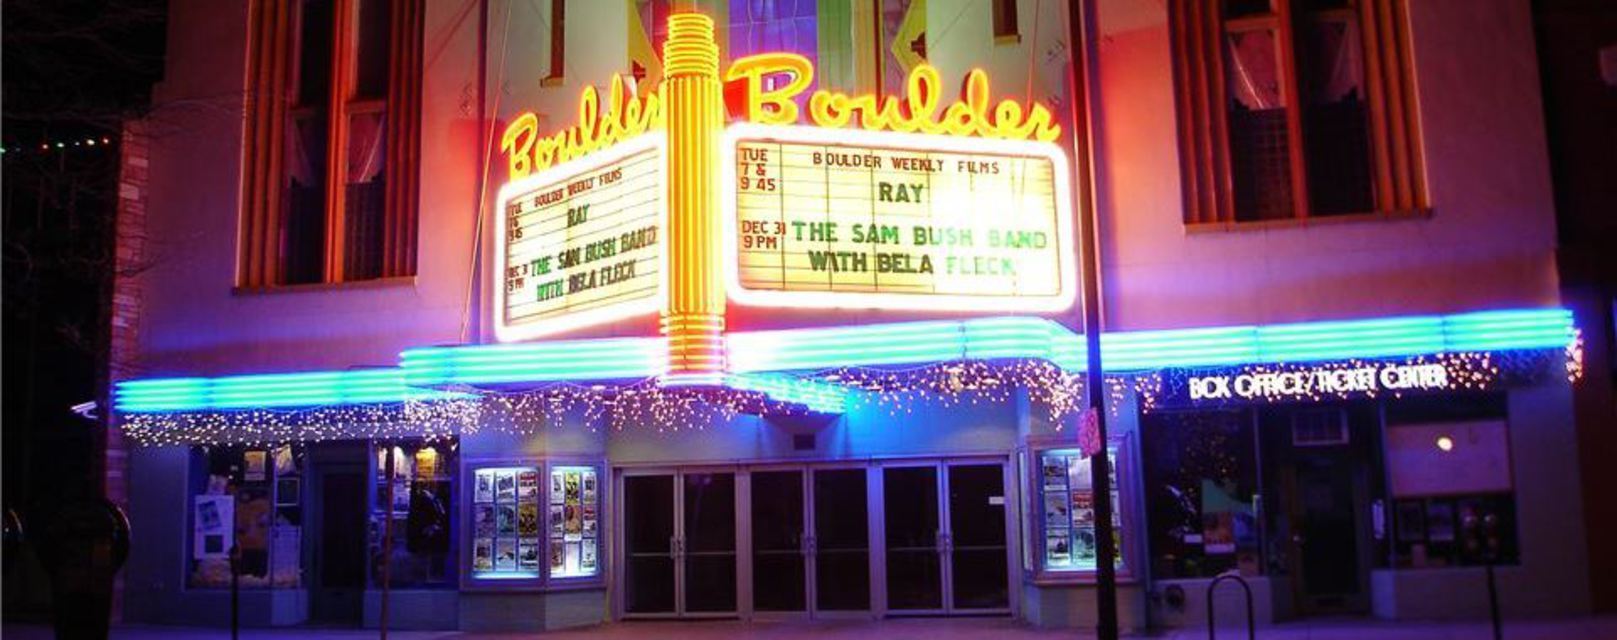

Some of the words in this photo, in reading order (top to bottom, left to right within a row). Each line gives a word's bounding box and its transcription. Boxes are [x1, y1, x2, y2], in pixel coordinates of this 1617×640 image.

[727, 52, 1061, 142] Boulder
[502, 72, 662, 180] Boulder
[741, 148, 768, 162] TUE
[813, 152, 882, 168] BOULDER
[891, 157, 944, 172] WEEKLY
[958, 161, 1000, 174] FILMS
[740, 163, 749, 175] 7
[756, 163, 766, 176] &
[740, 177, 750, 191] 9
[756, 178, 776, 191] 45
[879, 182, 923, 203] RAY
[534, 188, 563, 207] BOULDER
[567, 204, 590, 228] RAY
[741, 221, 769, 234] DEC
[774, 222, 786, 235] 31
[792, 221, 838, 242] THE
[852, 224, 899, 245] SAM
[913, 225, 973, 246] BUSH
[989, 229, 1048, 249] BAND
[531, 256, 552, 277] THE
[557, 247, 580, 270] SAM
[585, 236, 616, 263] BUSH
[621, 226, 657, 253] BAND
[743, 236, 753, 248] 9
[756, 237, 777, 249] PM
[808, 250, 867, 272] WITH
[877, 252, 934, 275] BELA
[946, 257, 1017, 275] FLECK
[536, 278, 564, 302] WITH
[569, 269, 596, 293] BELA
[600, 259, 637, 286] FLECK
[1189, 376, 1231, 399] BOX
[1380, 363, 1448, 389] CENTER
